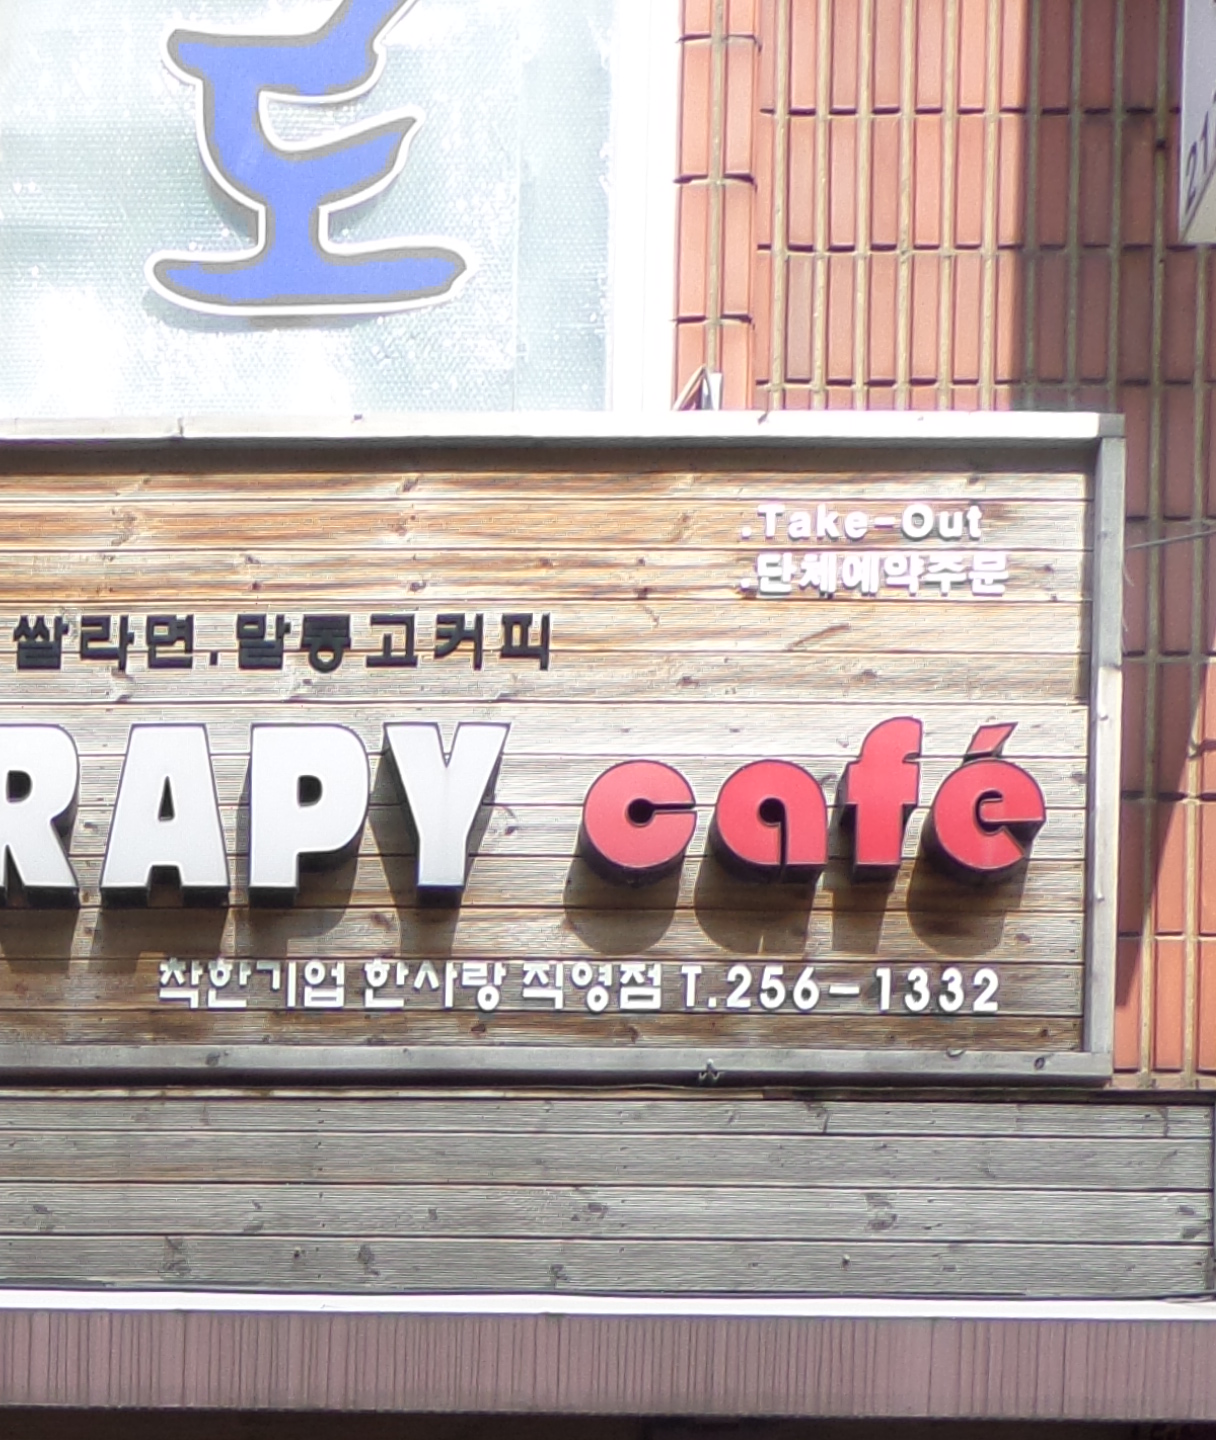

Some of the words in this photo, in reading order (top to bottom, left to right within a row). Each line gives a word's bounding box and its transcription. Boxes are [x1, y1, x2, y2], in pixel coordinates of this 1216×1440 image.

[583, 715, 1047, 873] café
[159, 959, 344, 1010] 착한기업
[364, 959, 507, 1012] 한사랑
[522, 962, 661, 1013] 직영점
